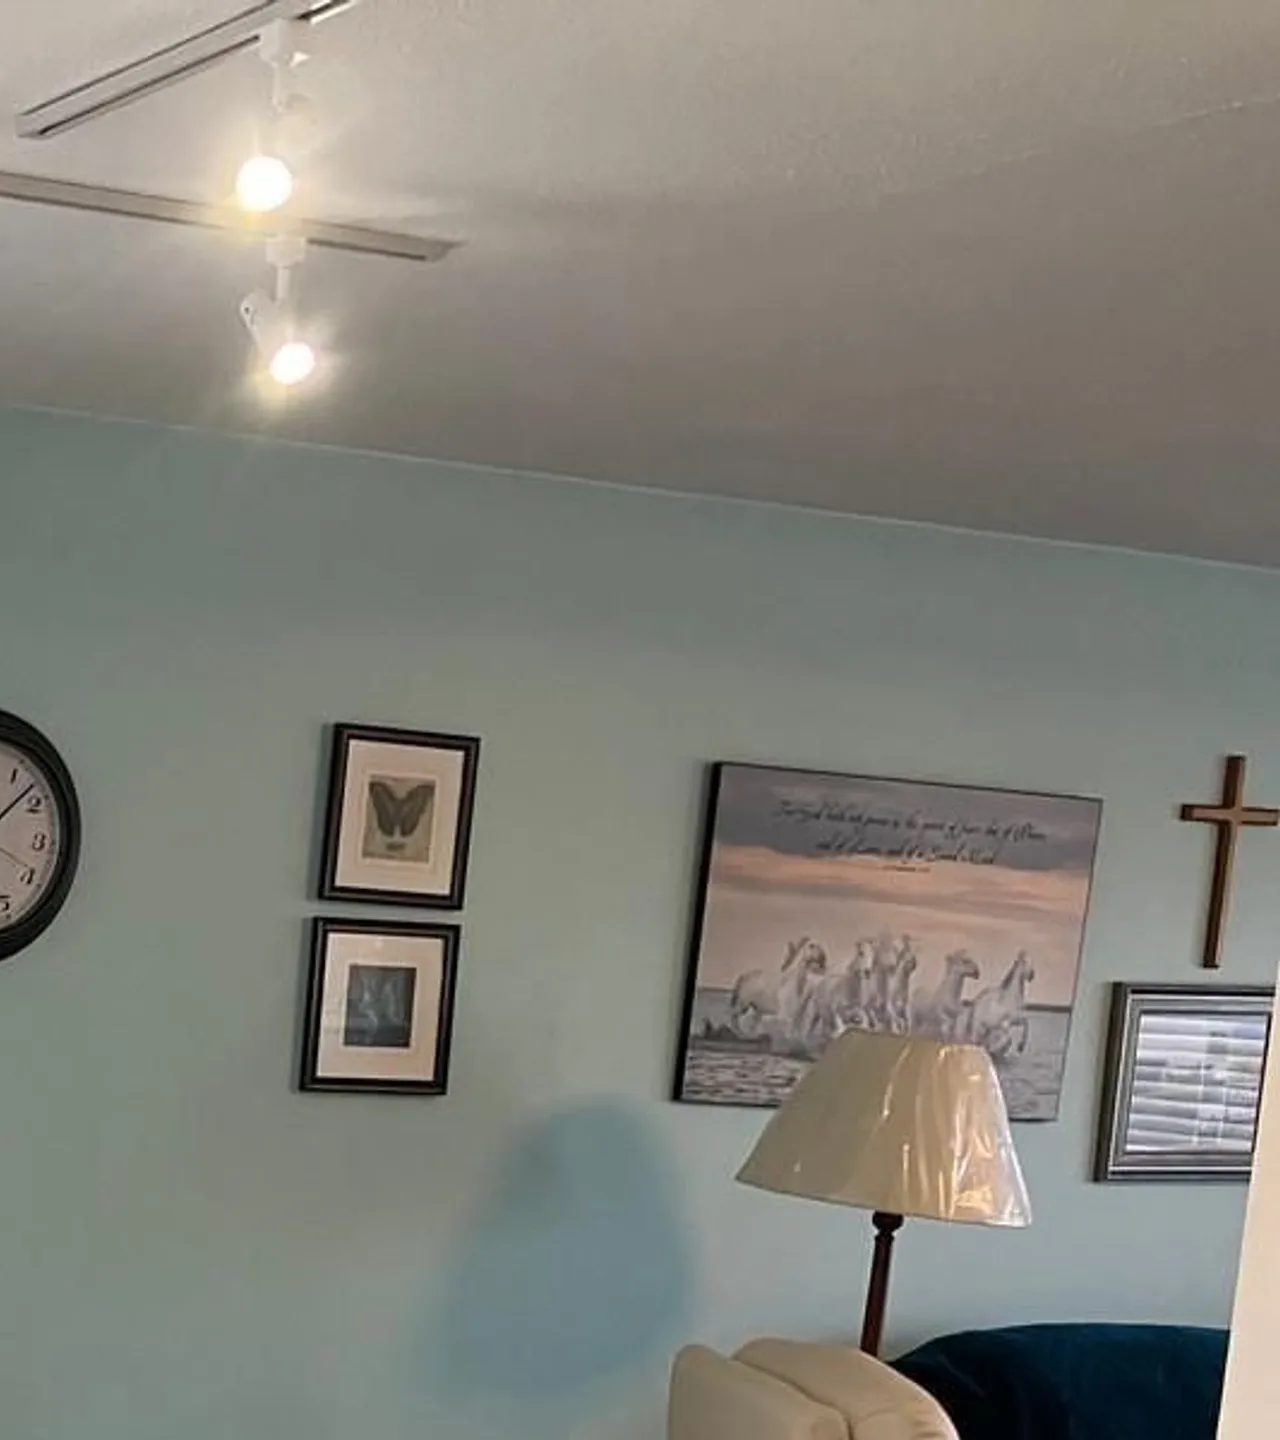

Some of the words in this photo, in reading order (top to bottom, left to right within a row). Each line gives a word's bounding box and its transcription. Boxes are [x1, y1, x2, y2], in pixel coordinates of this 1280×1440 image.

[10, 768, 18, 784] 1
[26, 796, 42, 814] 2
[32, 833, 46, 851] 3
[19, 868, 35, 885] 4
